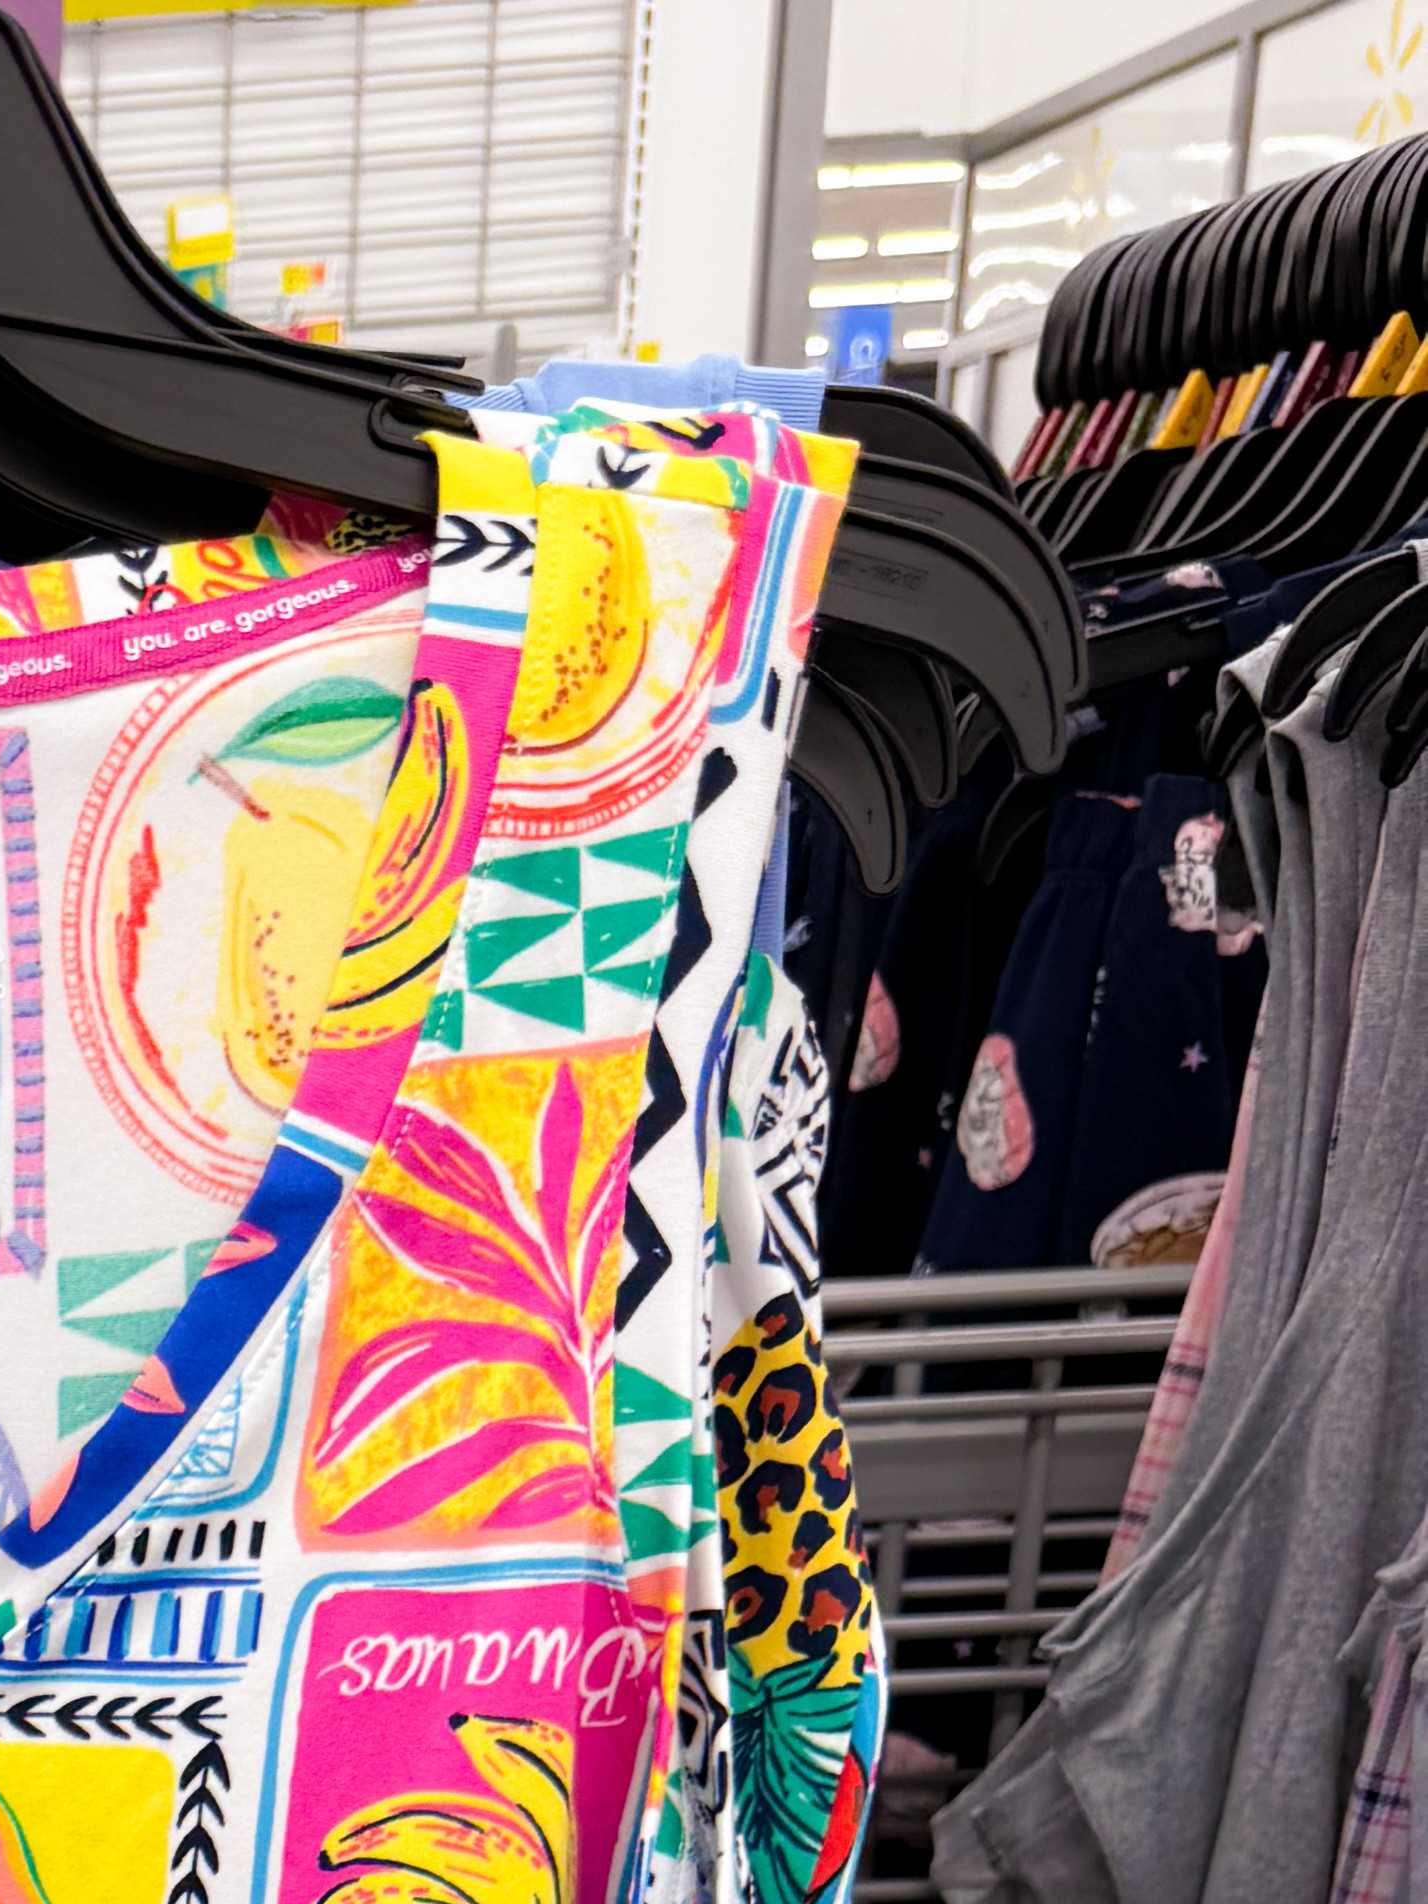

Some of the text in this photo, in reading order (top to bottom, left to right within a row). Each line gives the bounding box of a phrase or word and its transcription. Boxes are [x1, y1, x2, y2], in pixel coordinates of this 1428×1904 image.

[123, 579, 357, 661] you. are. gorgeous.
